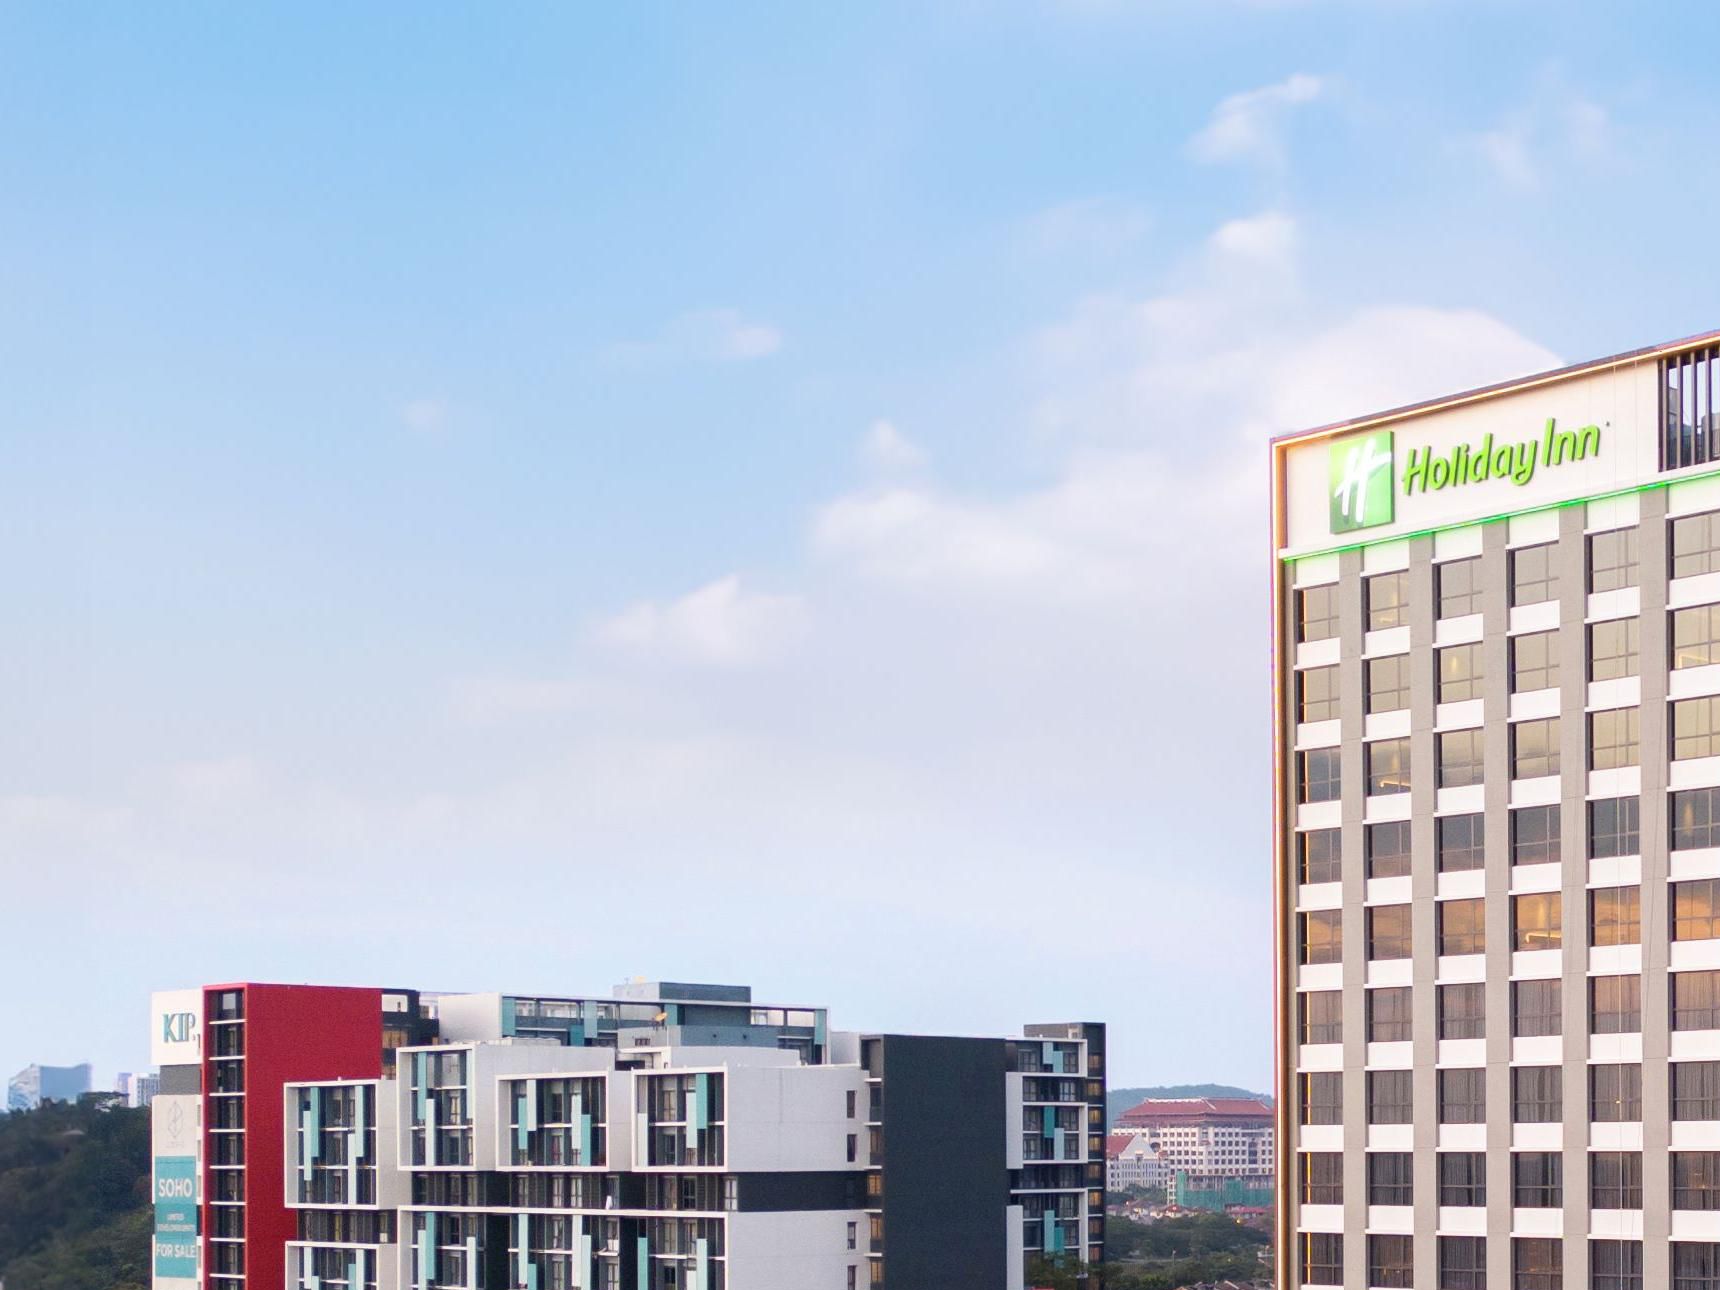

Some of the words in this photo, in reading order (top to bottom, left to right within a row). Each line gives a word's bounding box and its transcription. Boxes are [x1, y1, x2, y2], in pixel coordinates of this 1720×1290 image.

[1401, 432, 1538, 496] Holiday
[1541, 417, 1601, 467] Inn
[158, 1178, 193, 1198] SOHO
[156, 1243, 173, 1258] FOR
[174, 1244, 197, 1258] SALE
